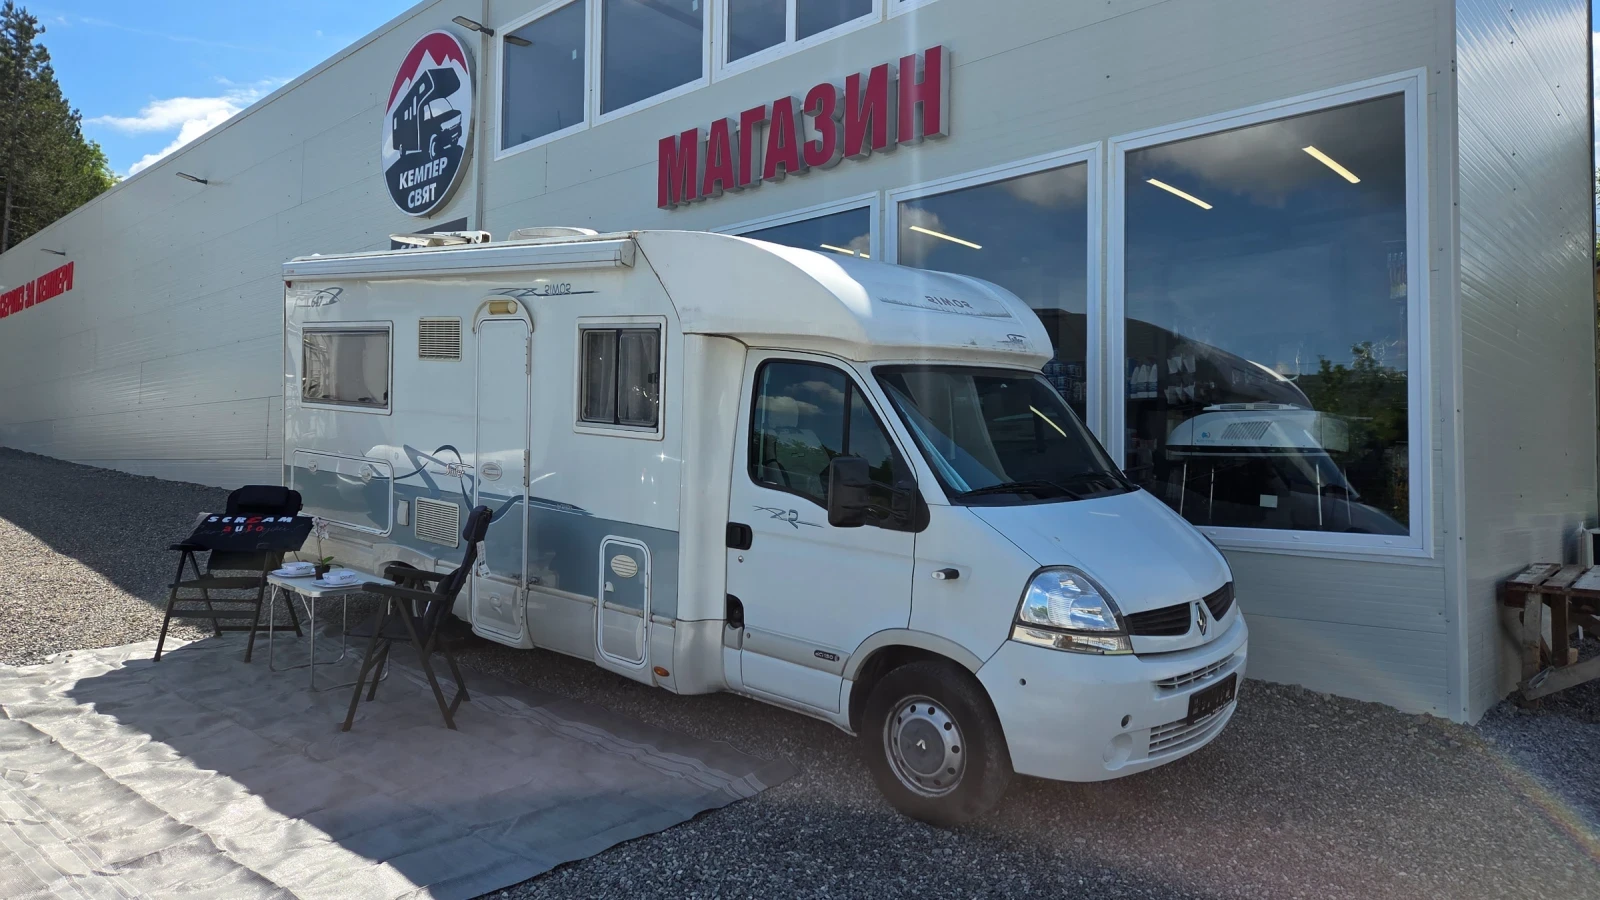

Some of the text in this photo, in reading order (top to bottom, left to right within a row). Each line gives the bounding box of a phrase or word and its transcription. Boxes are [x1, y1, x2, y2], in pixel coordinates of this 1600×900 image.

[658, 45, 944, 208] МАГАЗИН
[399, 157, 448, 190] КЕМПЕР
[408, 182, 437, 208] СВЯТ
[207, 516, 293, 524] SCREAM
